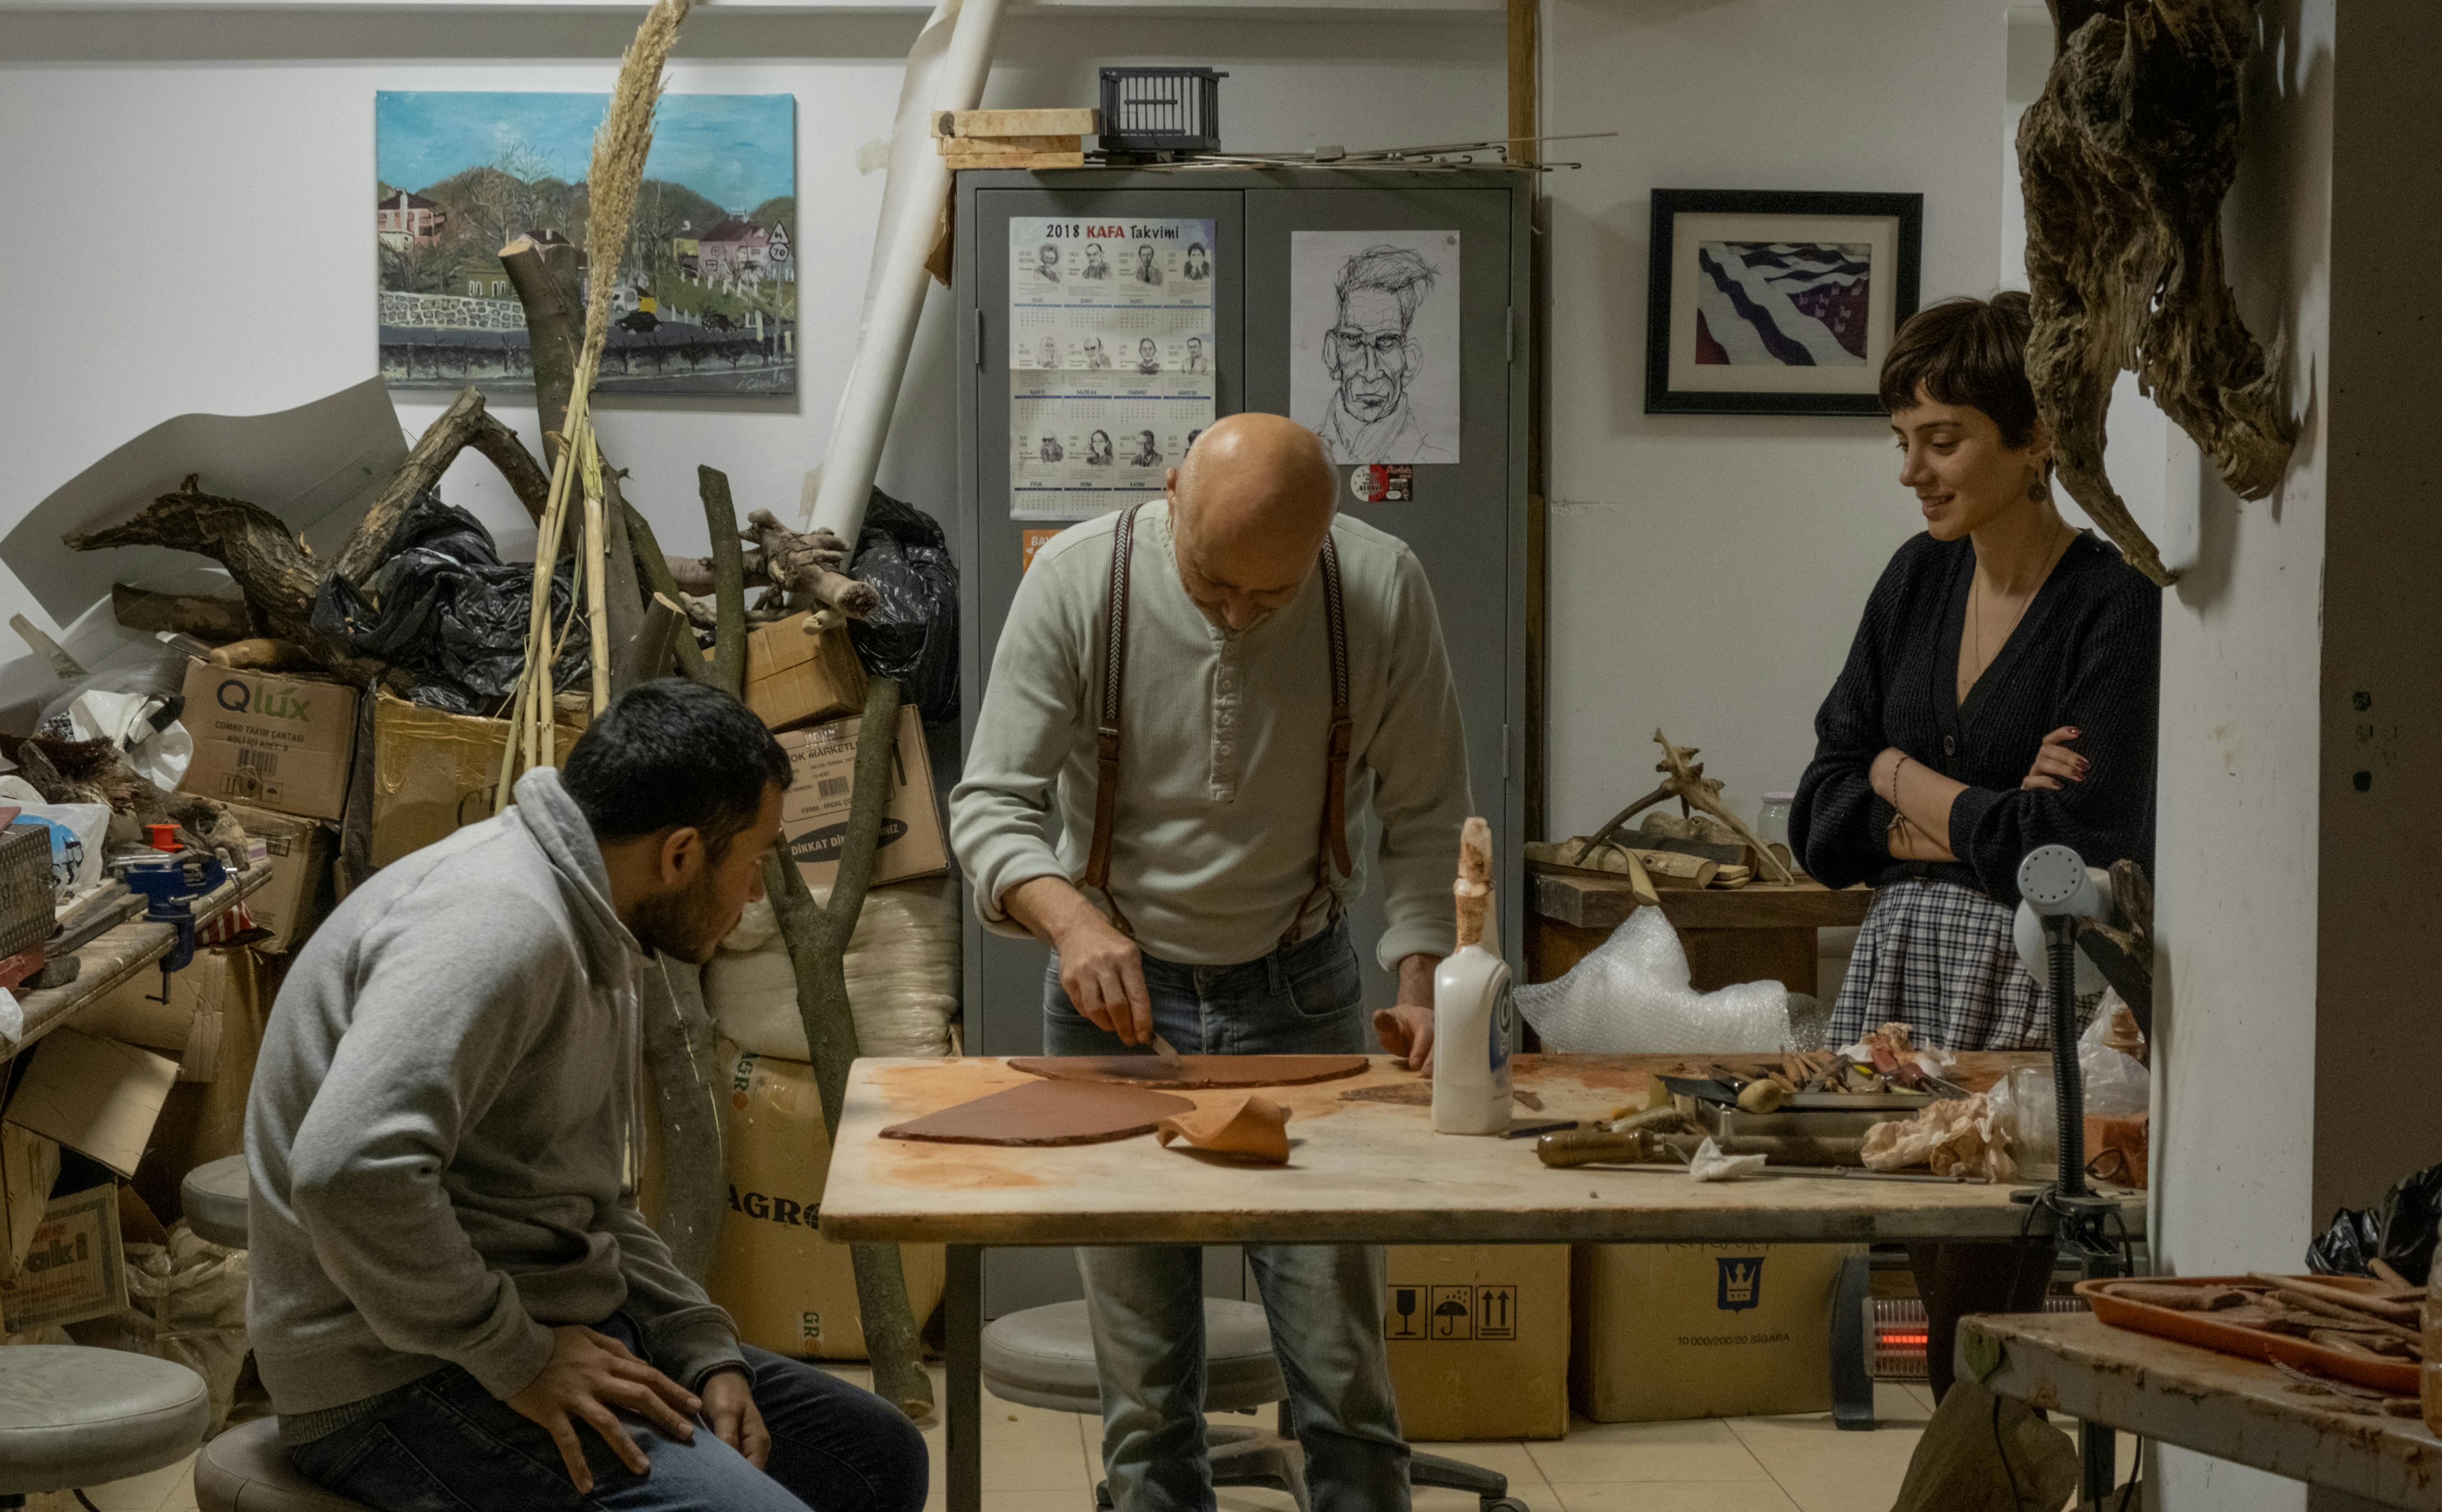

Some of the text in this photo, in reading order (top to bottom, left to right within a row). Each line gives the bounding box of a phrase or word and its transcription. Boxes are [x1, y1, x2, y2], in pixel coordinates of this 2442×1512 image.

[1046, 225, 1179, 239] 2018 KAFA Takvimi
[773, 248, 785, 257] 70
[215, 721, 304, 742] COMBO TAKIM ÇANTASI
[790, 741, 858, 762] OK MARKETL
[801, 805, 820, 814] FİRMA
[824, 800, 843, 809] ERDAL
[791, 839, 828, 855] DİKKAT
[1751, 1333, 1789, 1343] SİGARA
